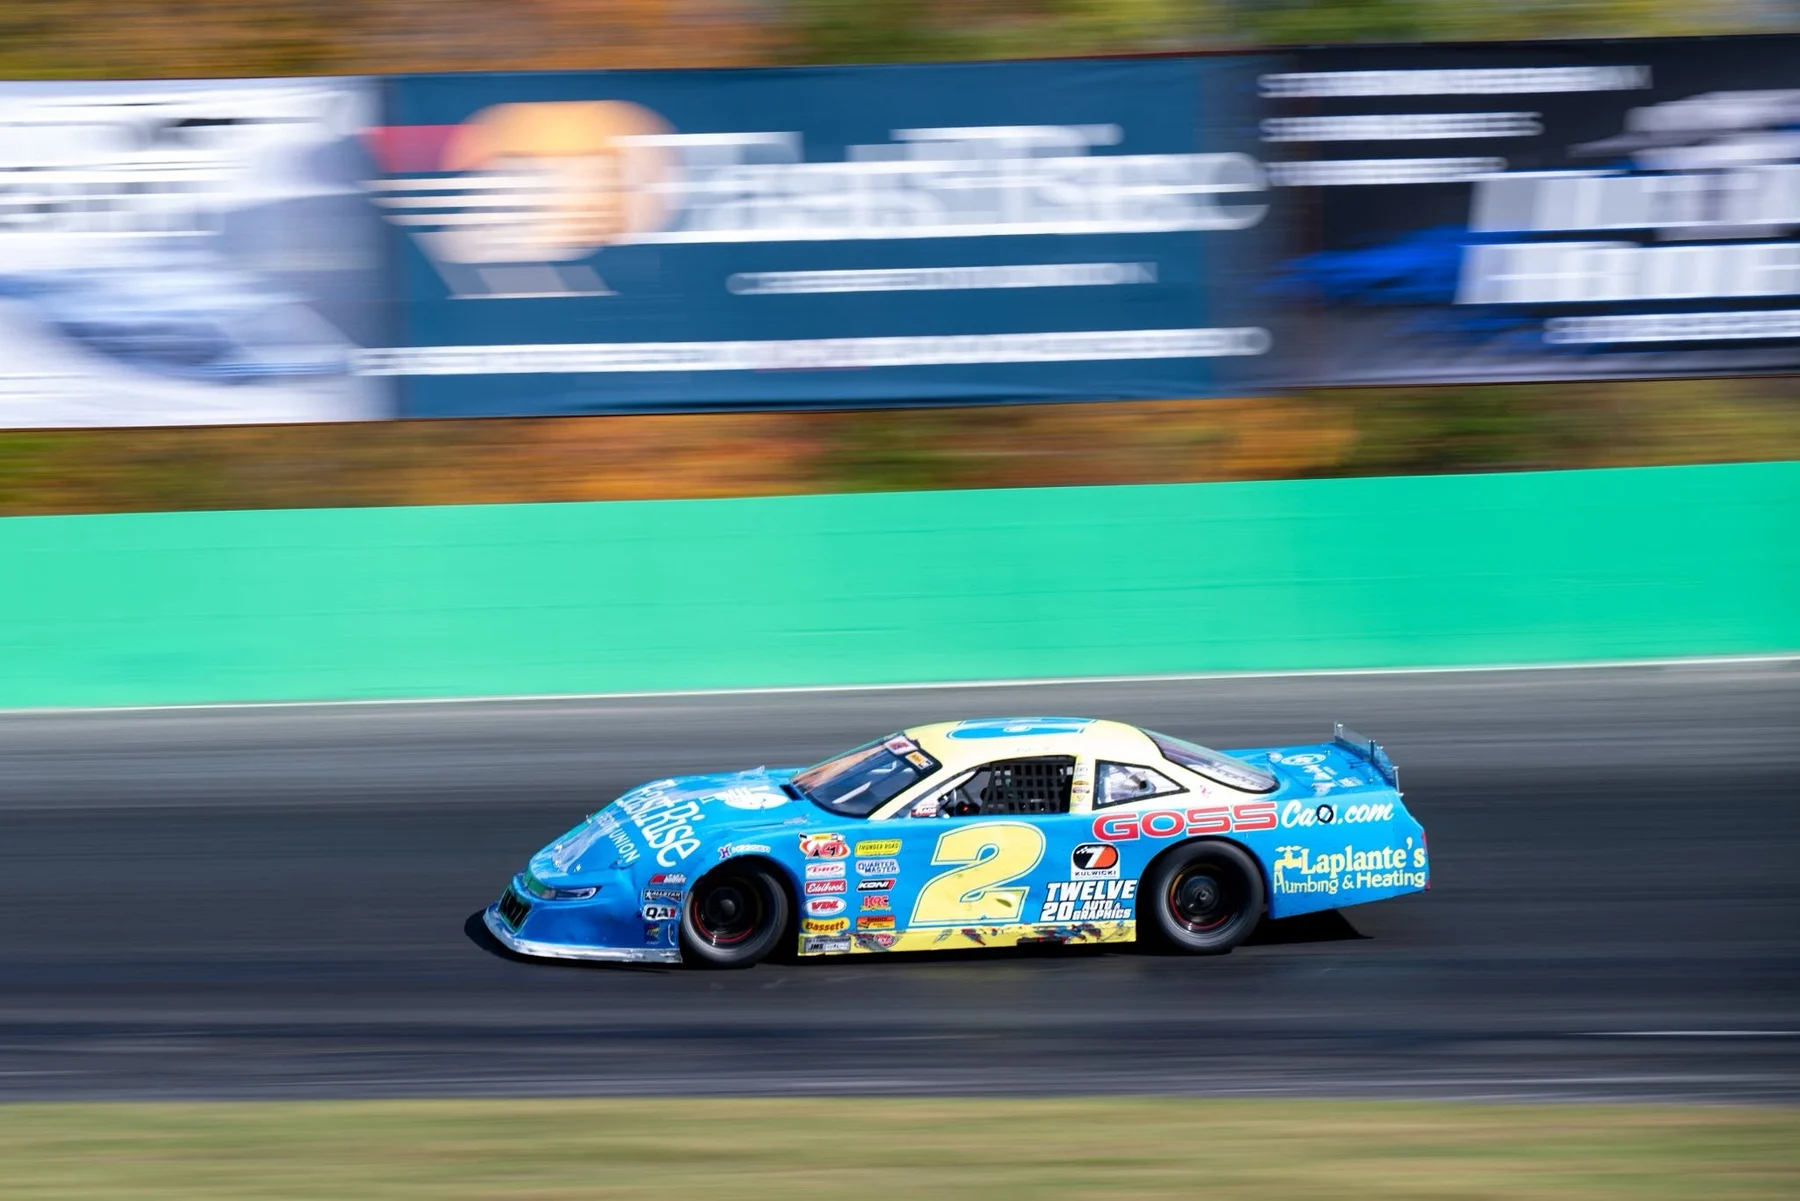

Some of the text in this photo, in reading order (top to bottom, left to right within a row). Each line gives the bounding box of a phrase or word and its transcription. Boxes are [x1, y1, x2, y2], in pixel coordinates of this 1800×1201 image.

[1093, 801, 1278, 842] GOSS
[608, 827, 641, 864] UNION
[1300, 836, 1426, 879] Laplante's
[908, 821, 1047, 927] 2
[1074, 869, 1117, 877] KULWICKI
[1356, 869, 1426, 888] Heating
[808, 881, 846, 893] Edelbrock
[859, 881, 889, 889] KONI
[1046, 879, 1138, 902] TWELVE
[645, 906, 677, 919] QA1
[1040, 901, 1075, 922] 20
[1081, 900, 1114, 911] AUTO
[1071, 908, 1132, 921] GRAPHICS
[806, 920, 844, 931] Bassett
